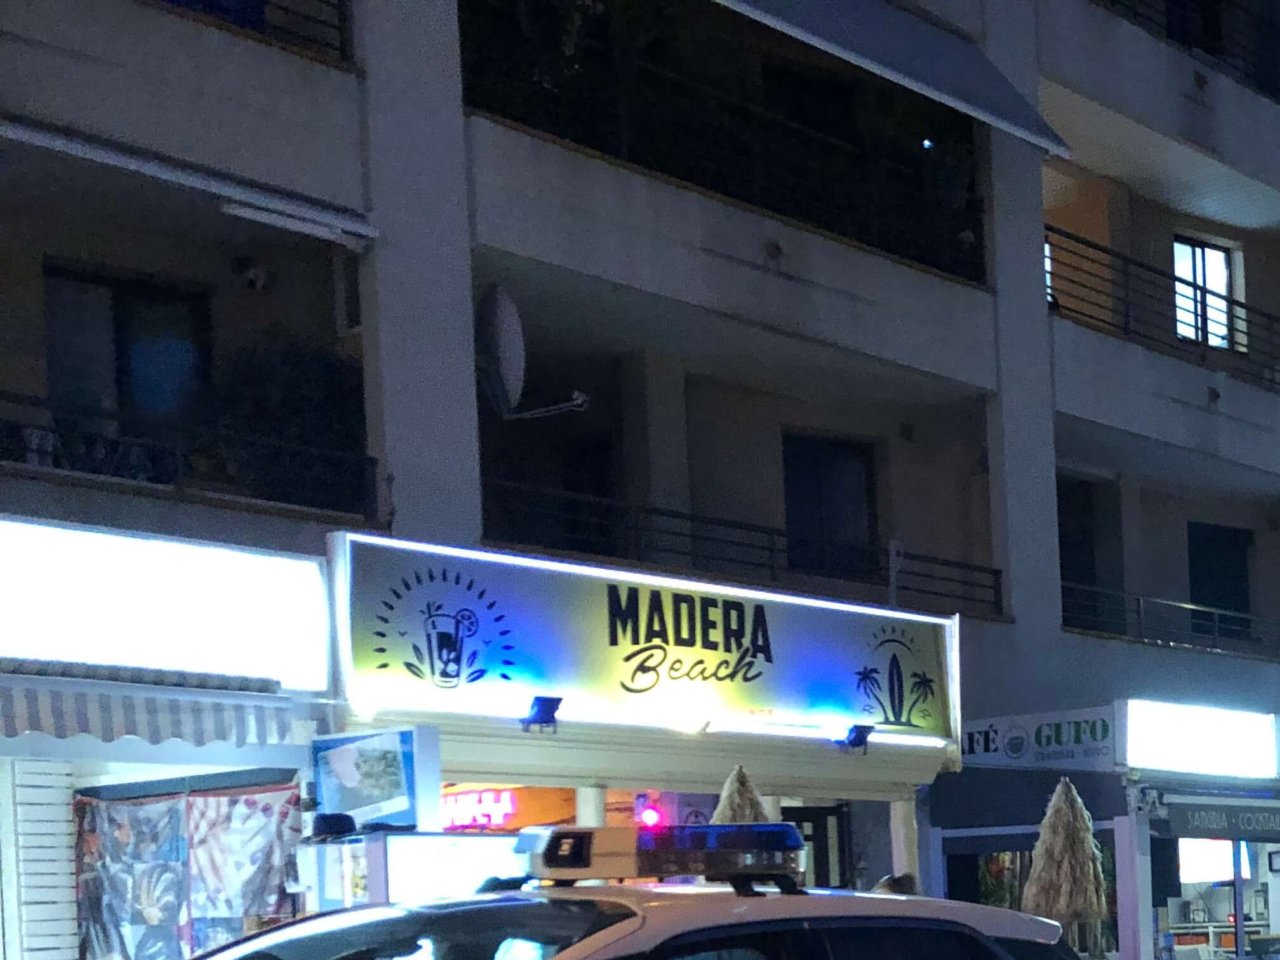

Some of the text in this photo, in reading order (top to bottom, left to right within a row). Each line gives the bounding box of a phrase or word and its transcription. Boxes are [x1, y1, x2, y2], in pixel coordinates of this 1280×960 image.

[607, 583, 774, 665] MADERA
[620, 643, 764, 694] Beach
[1034, 717, 1110, 749] GUFO
